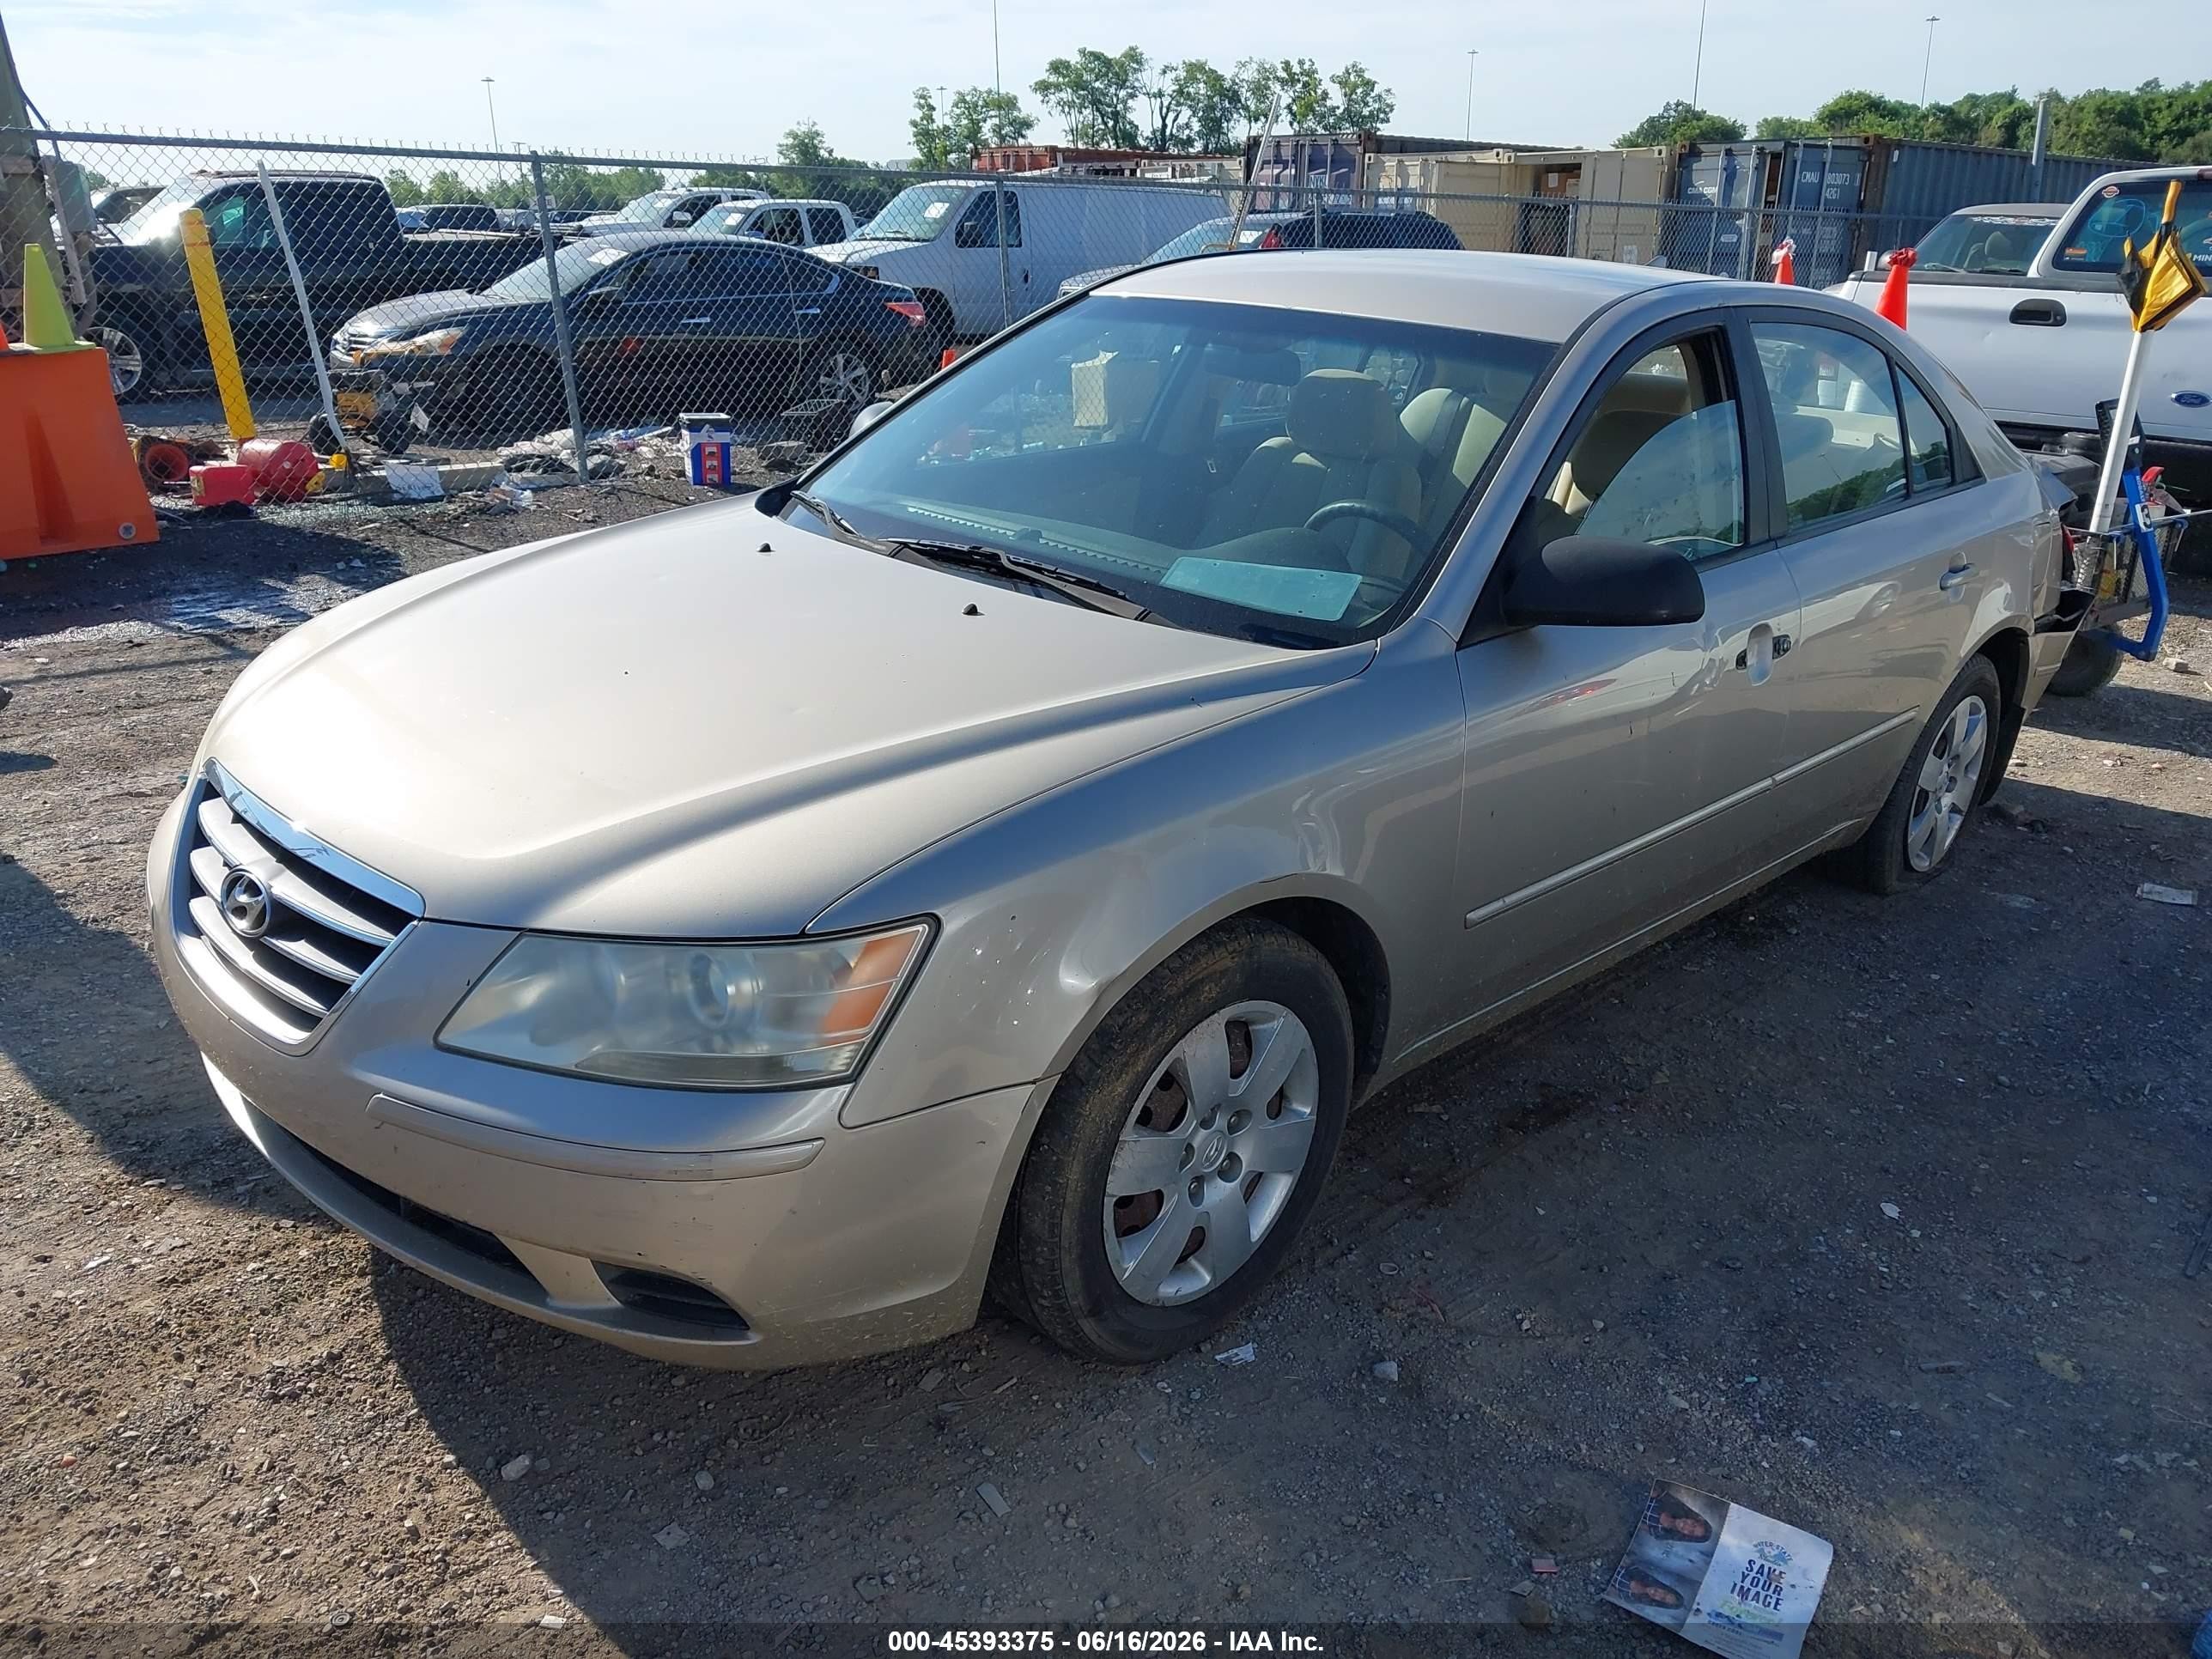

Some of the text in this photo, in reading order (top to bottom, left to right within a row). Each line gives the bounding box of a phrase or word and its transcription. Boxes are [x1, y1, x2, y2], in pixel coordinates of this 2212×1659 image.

[1801, 171, 1820, 183] CMAU
[1826, 172, 1850, 185] 803073
[1826, 187, 1840, 199] 42G1
[1741, 1571, 1784, 1596] YOUR
[1746, 1559, 1786, 1585] SAVE
[1729, 1581, 1784, 1612] IMAGE
